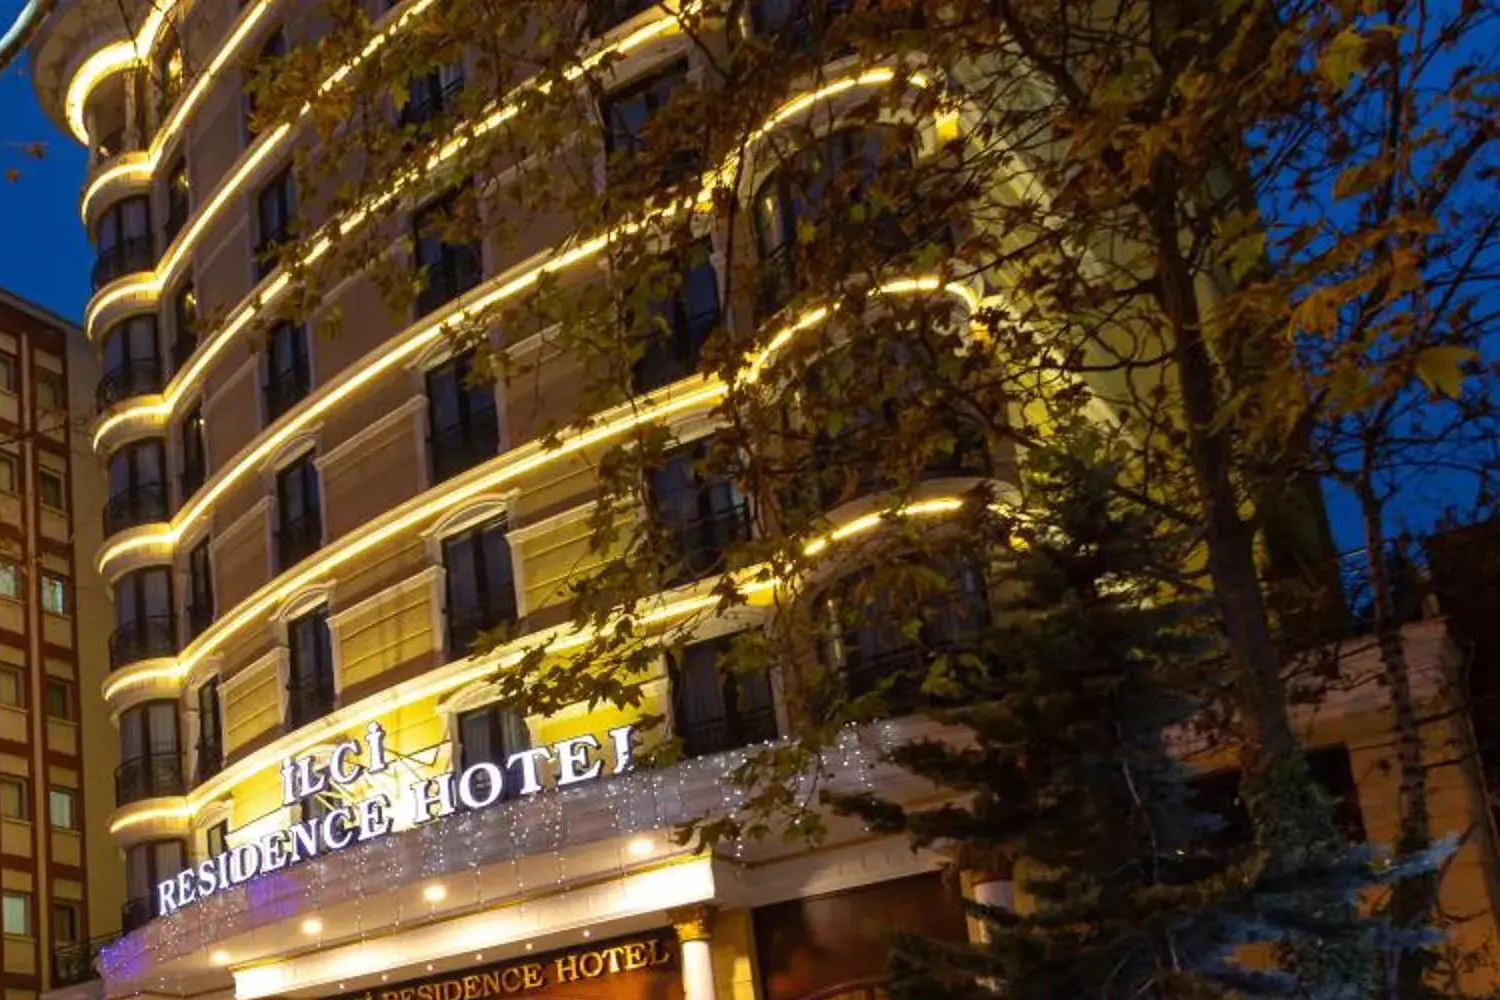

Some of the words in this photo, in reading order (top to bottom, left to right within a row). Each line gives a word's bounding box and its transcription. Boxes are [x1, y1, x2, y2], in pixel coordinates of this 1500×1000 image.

[281, 721, 387, 806] İLCİ
[157, 792, 394, 916] RESIDENCE
[555, 938, 669, 985] HOTEL
